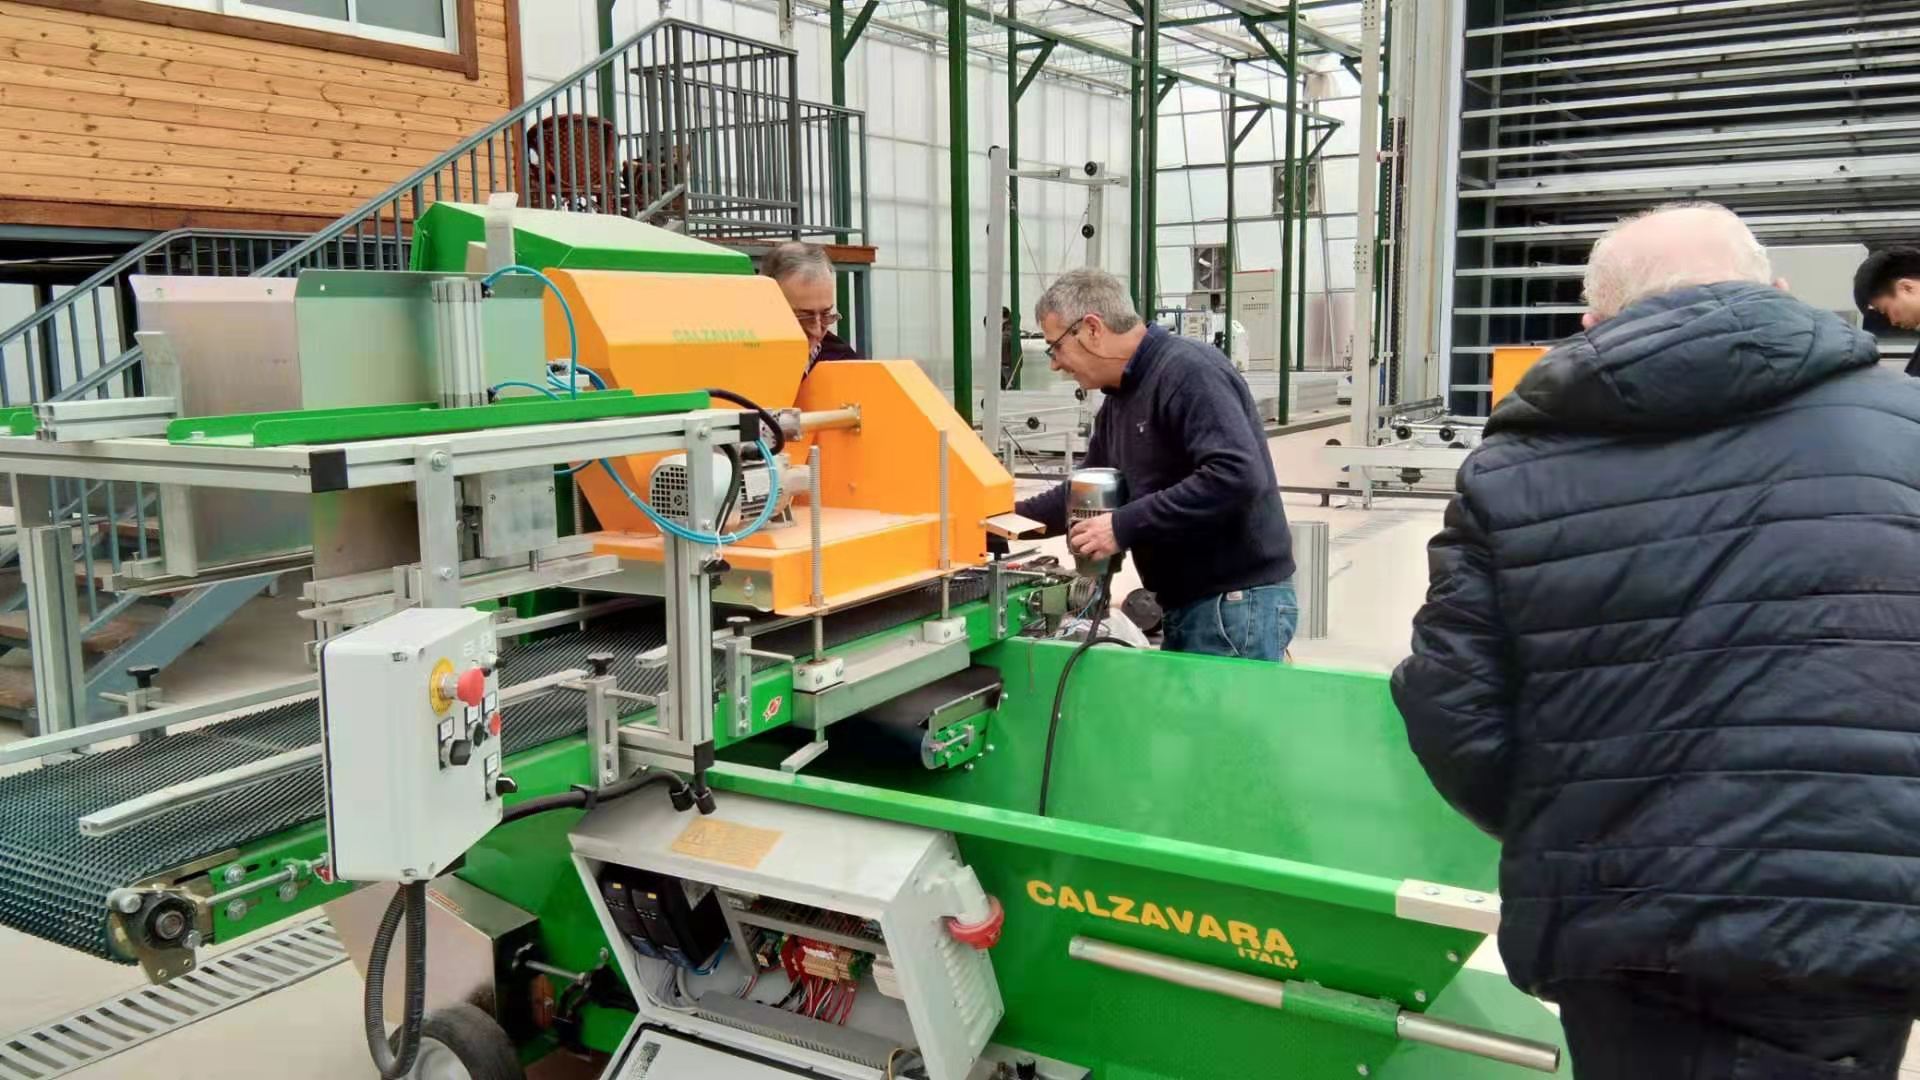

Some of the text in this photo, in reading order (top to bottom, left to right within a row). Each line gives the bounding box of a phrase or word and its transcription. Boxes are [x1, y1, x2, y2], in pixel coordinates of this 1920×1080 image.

[671, 328, 758, 343] CALZAVARA
[1026, 880, 1295, 957] CALZAVARA
[1238, 947, 1298, 969] ITALY
